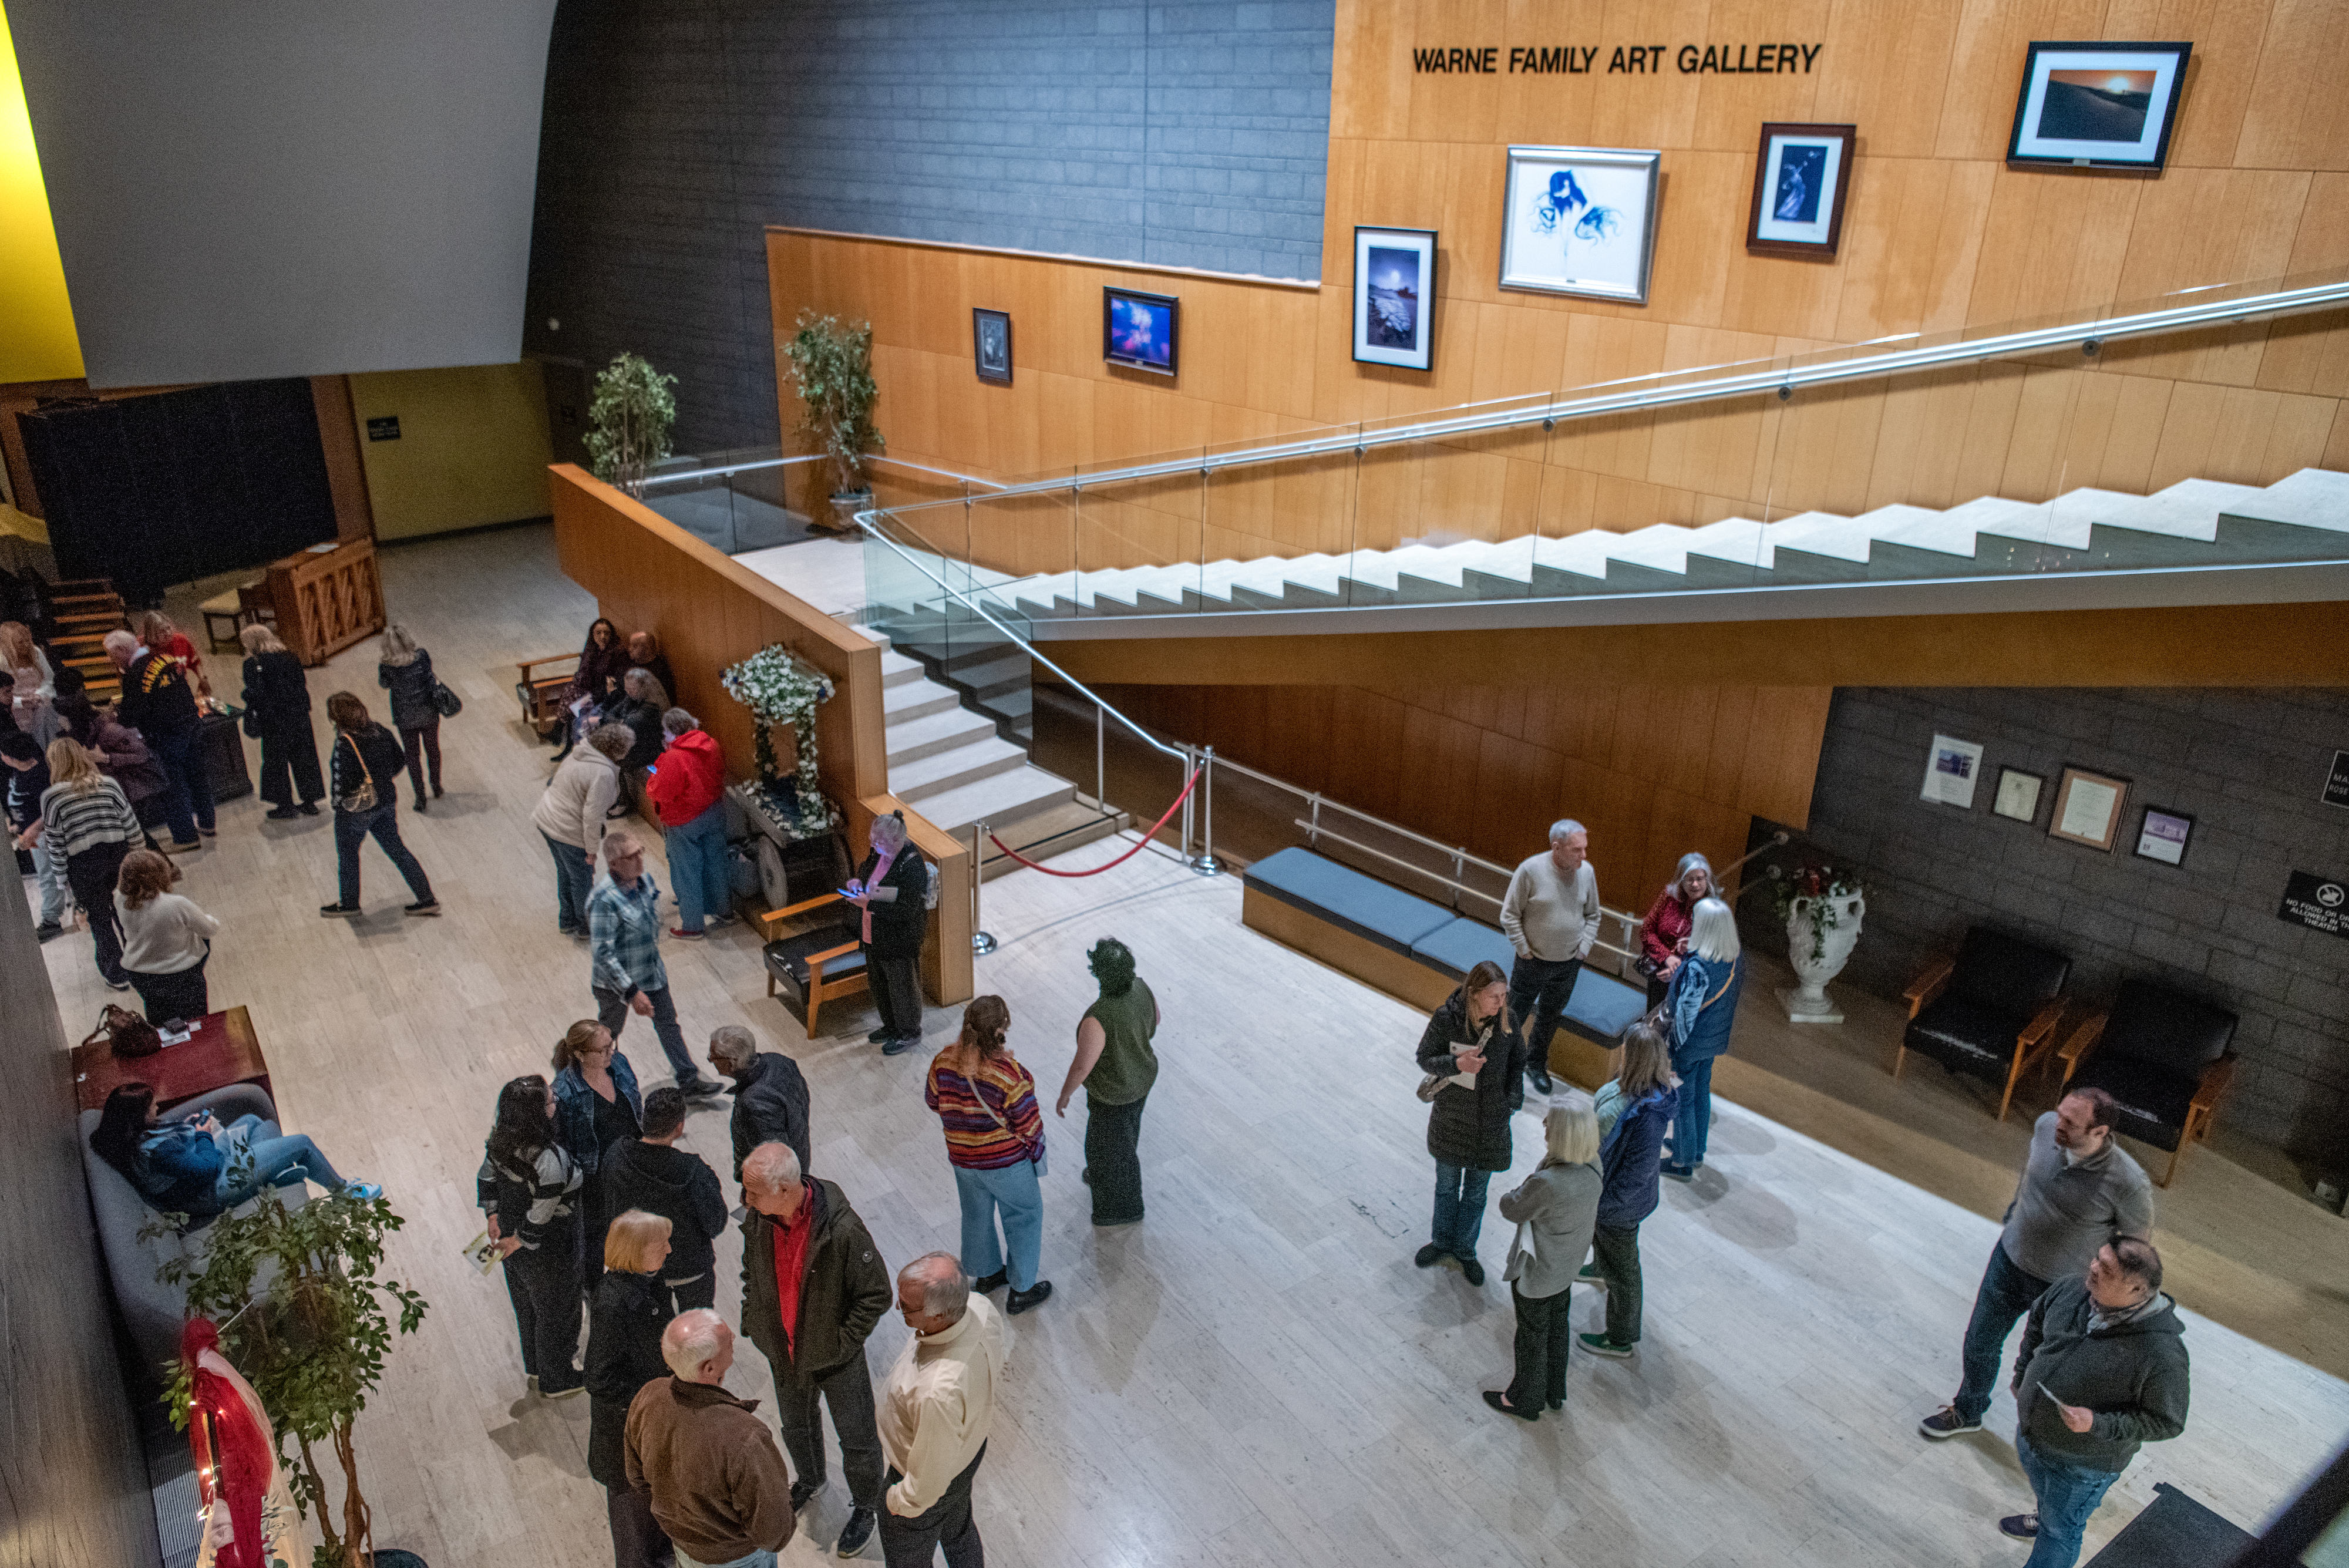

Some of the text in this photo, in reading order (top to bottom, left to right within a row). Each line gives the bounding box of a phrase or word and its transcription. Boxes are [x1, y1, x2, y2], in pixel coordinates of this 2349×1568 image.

[1413, 44, 1822, 73] WARNE FAMILY ART GALLERY
[2286, 897, 2298, 907] NO
[2300, 902, 2323, 914] FOOD
[2326, 909, 2337, 918] OR
[2290, 907, 2327, 922] ALLOWED
[2330, 917, 2338, 926] IN
[2304, 917, 2338, 931] THEATER
